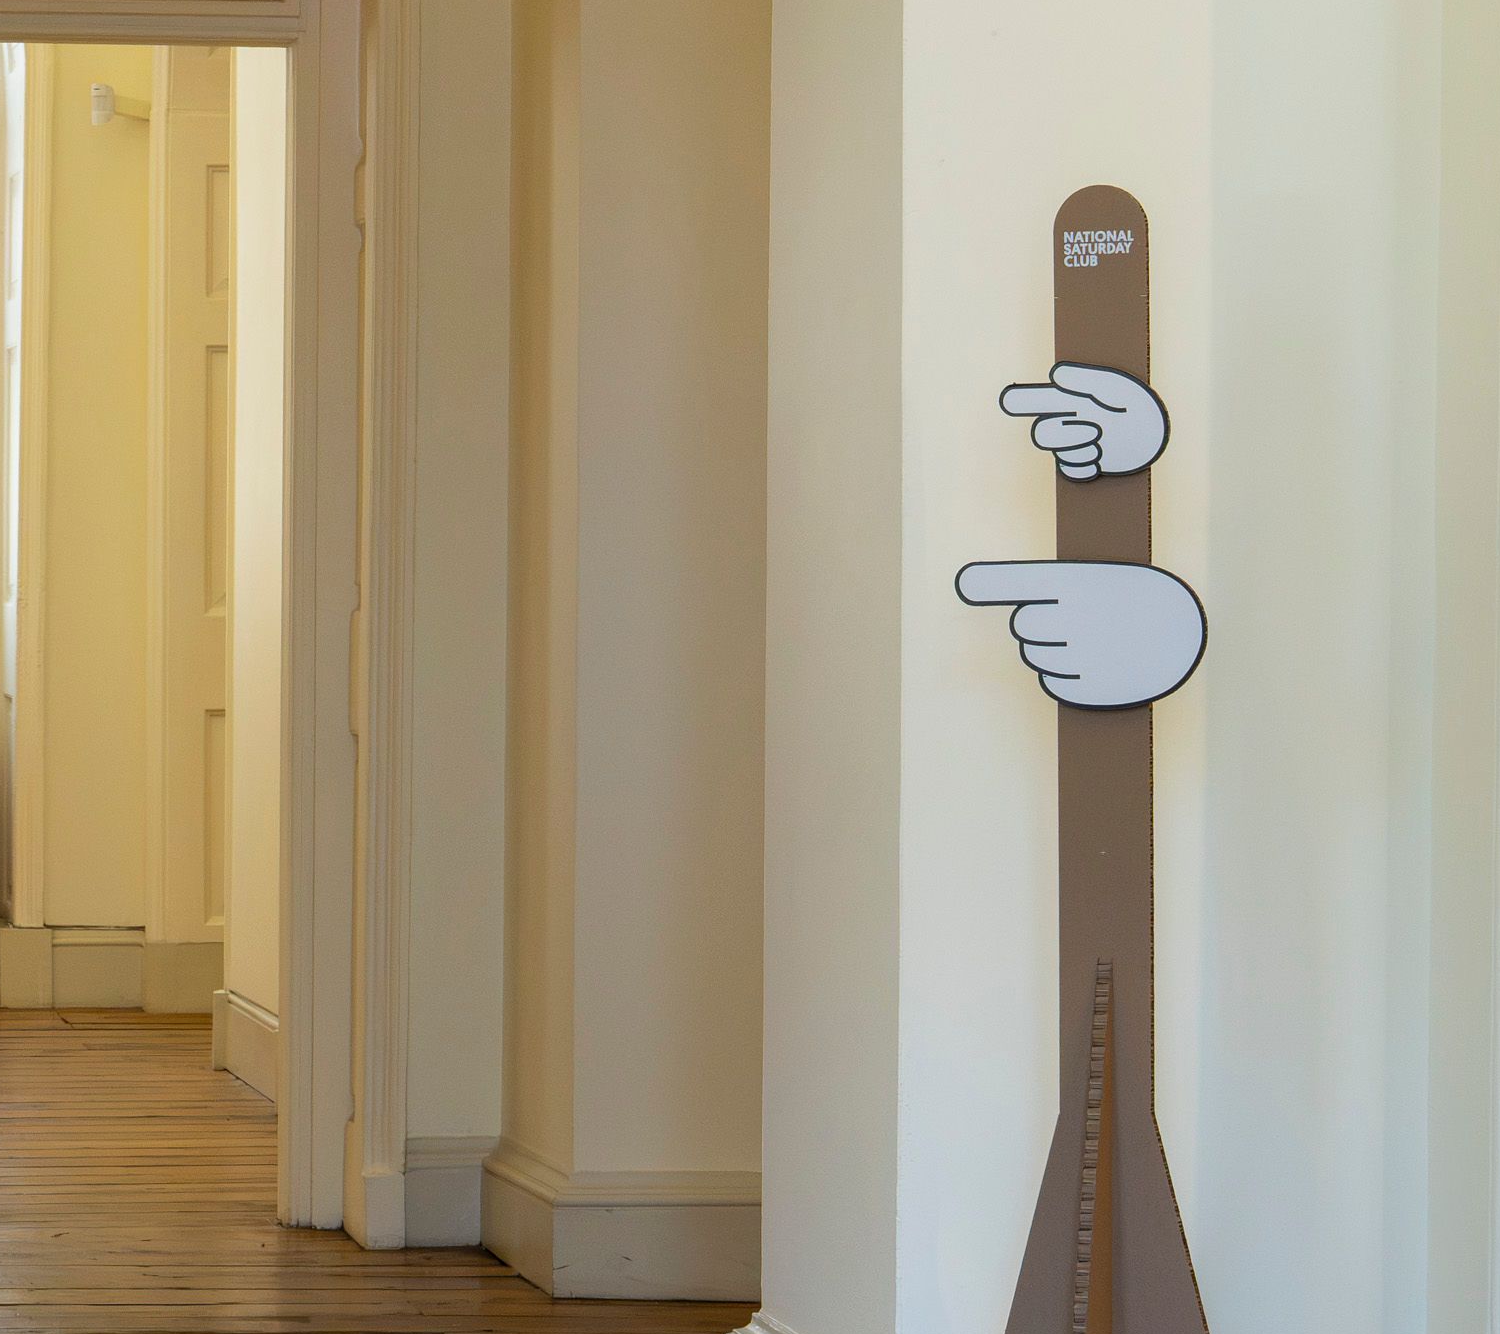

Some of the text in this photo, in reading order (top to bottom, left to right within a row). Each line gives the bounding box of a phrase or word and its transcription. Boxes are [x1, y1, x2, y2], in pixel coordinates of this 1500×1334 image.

[1063, 230, 1134, 243] NATIONAL
[1063, 242, 1132, 255] SATURDAY
[1063, 255, 1098, 267] CLUB
